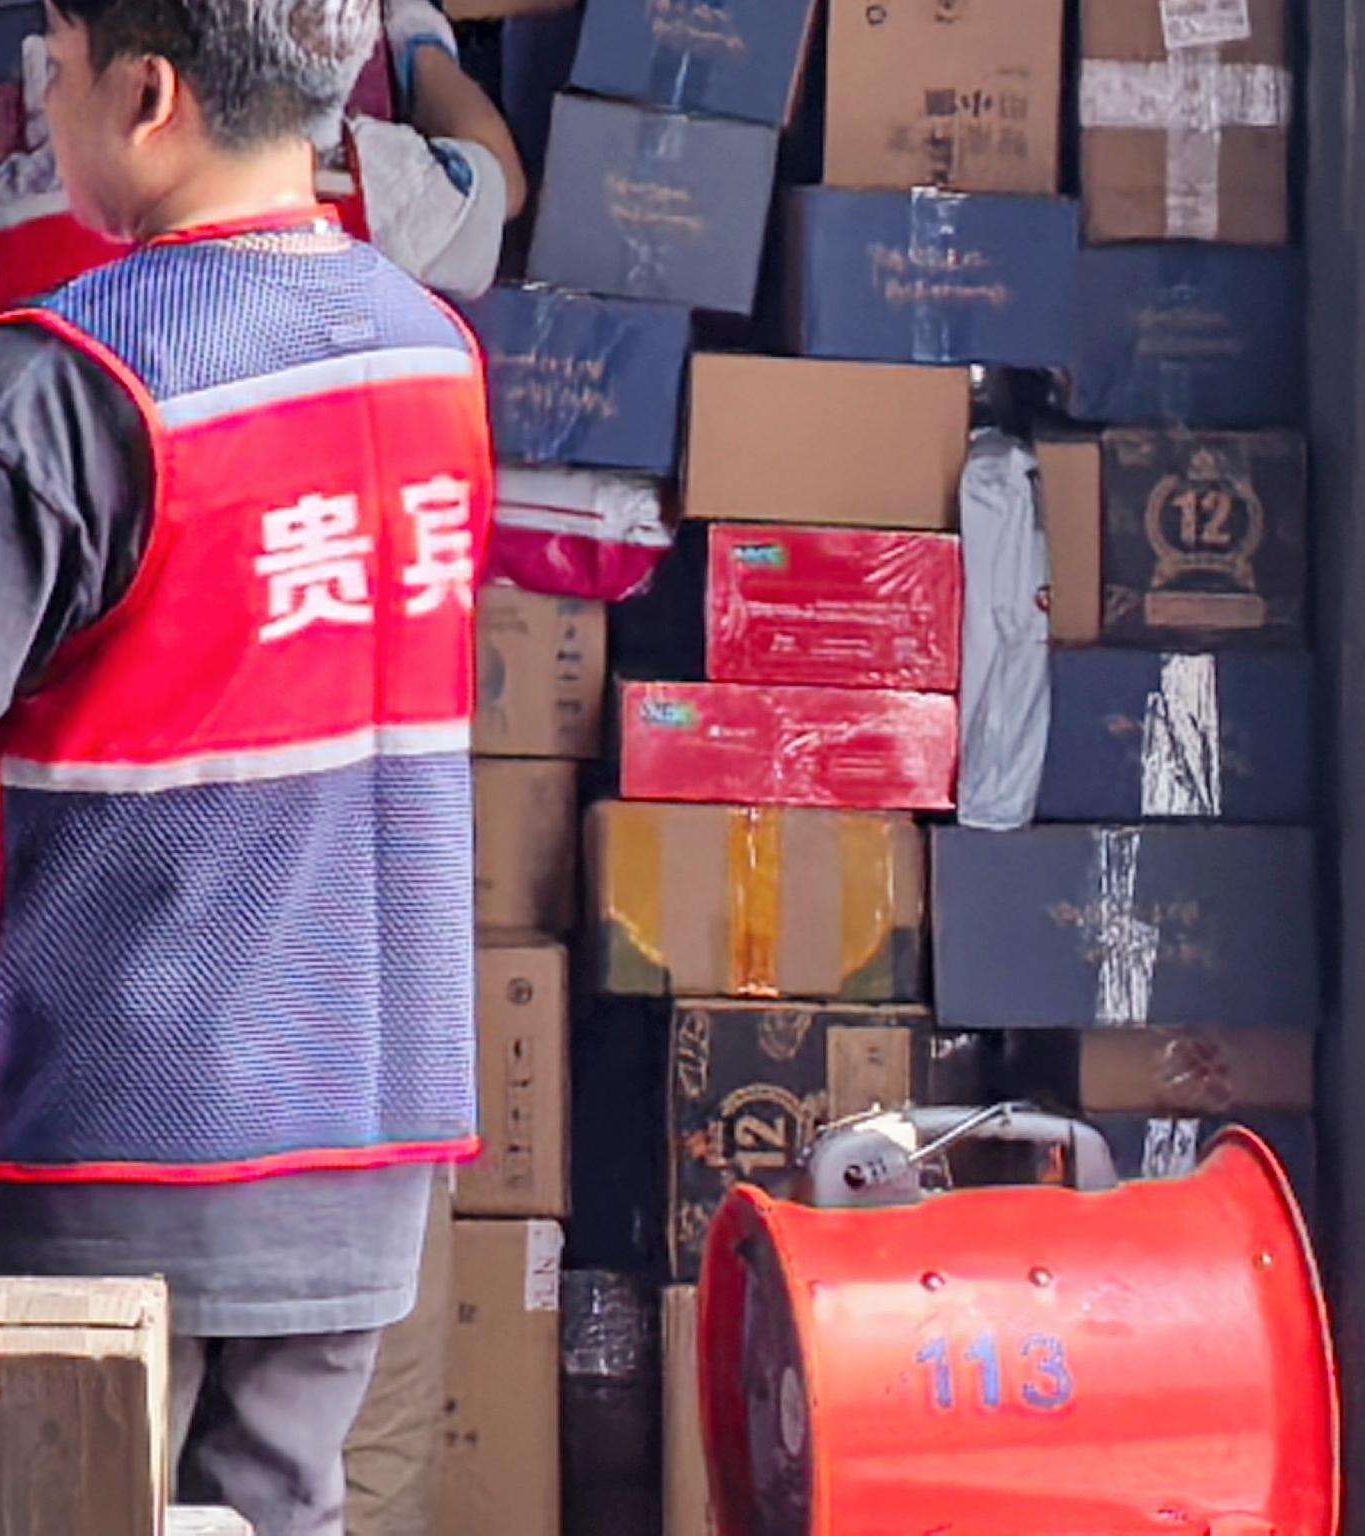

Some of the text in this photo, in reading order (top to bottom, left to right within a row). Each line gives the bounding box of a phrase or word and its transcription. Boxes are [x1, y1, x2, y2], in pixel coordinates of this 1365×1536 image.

[1169, 488, 1232, 549] 12
[254, 473, 471, 644] 贵宾
[731, 1110, 789, 1170] 12
[915, 1332, 1075, 1413] 113
